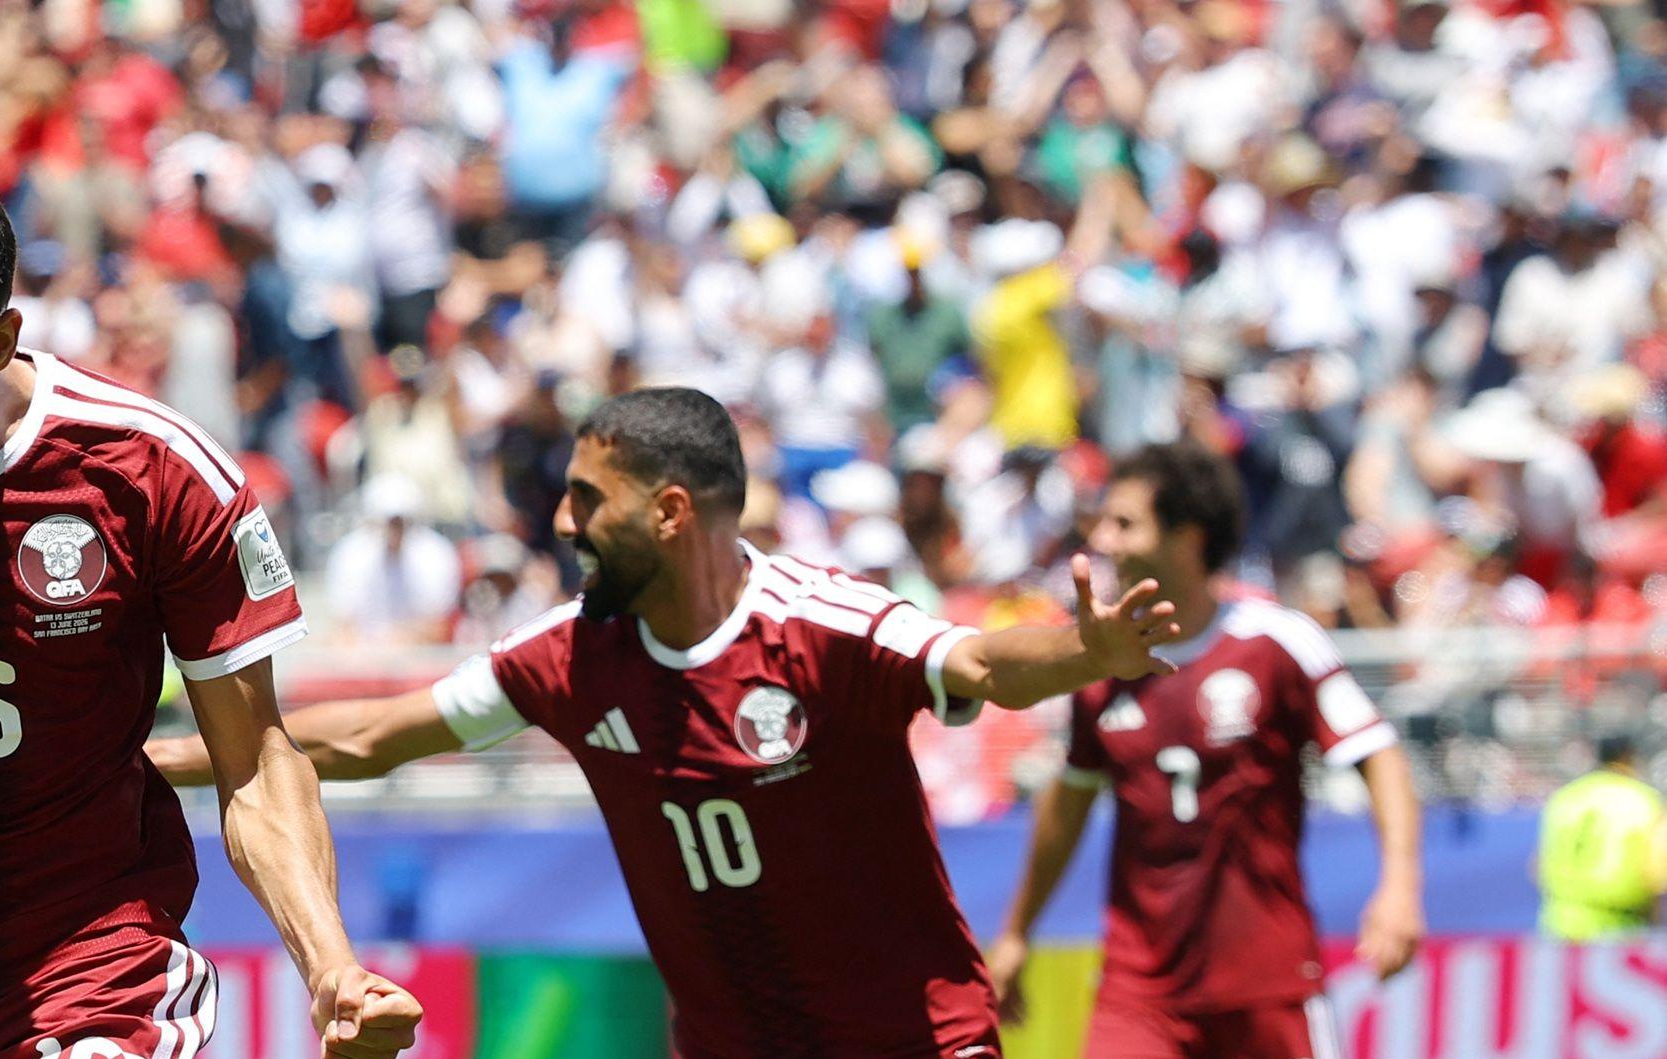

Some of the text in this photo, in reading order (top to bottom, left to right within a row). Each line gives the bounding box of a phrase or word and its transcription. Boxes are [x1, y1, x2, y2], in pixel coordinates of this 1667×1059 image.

[262, 554, 287, 577] PEAC
[46, 579, 86, 598] QFA
[55, 613, 63, 621] VS
[64, 609, 102, 620] SWITZERLAND
[58, 620, 73, 628] JUNE
[34, 630, 45, 638] SAN
[47, 628, 76, 637] FRANCISCO
[1156, 745, 1201, 823] 7
[660, 798, 762, 892] 10
